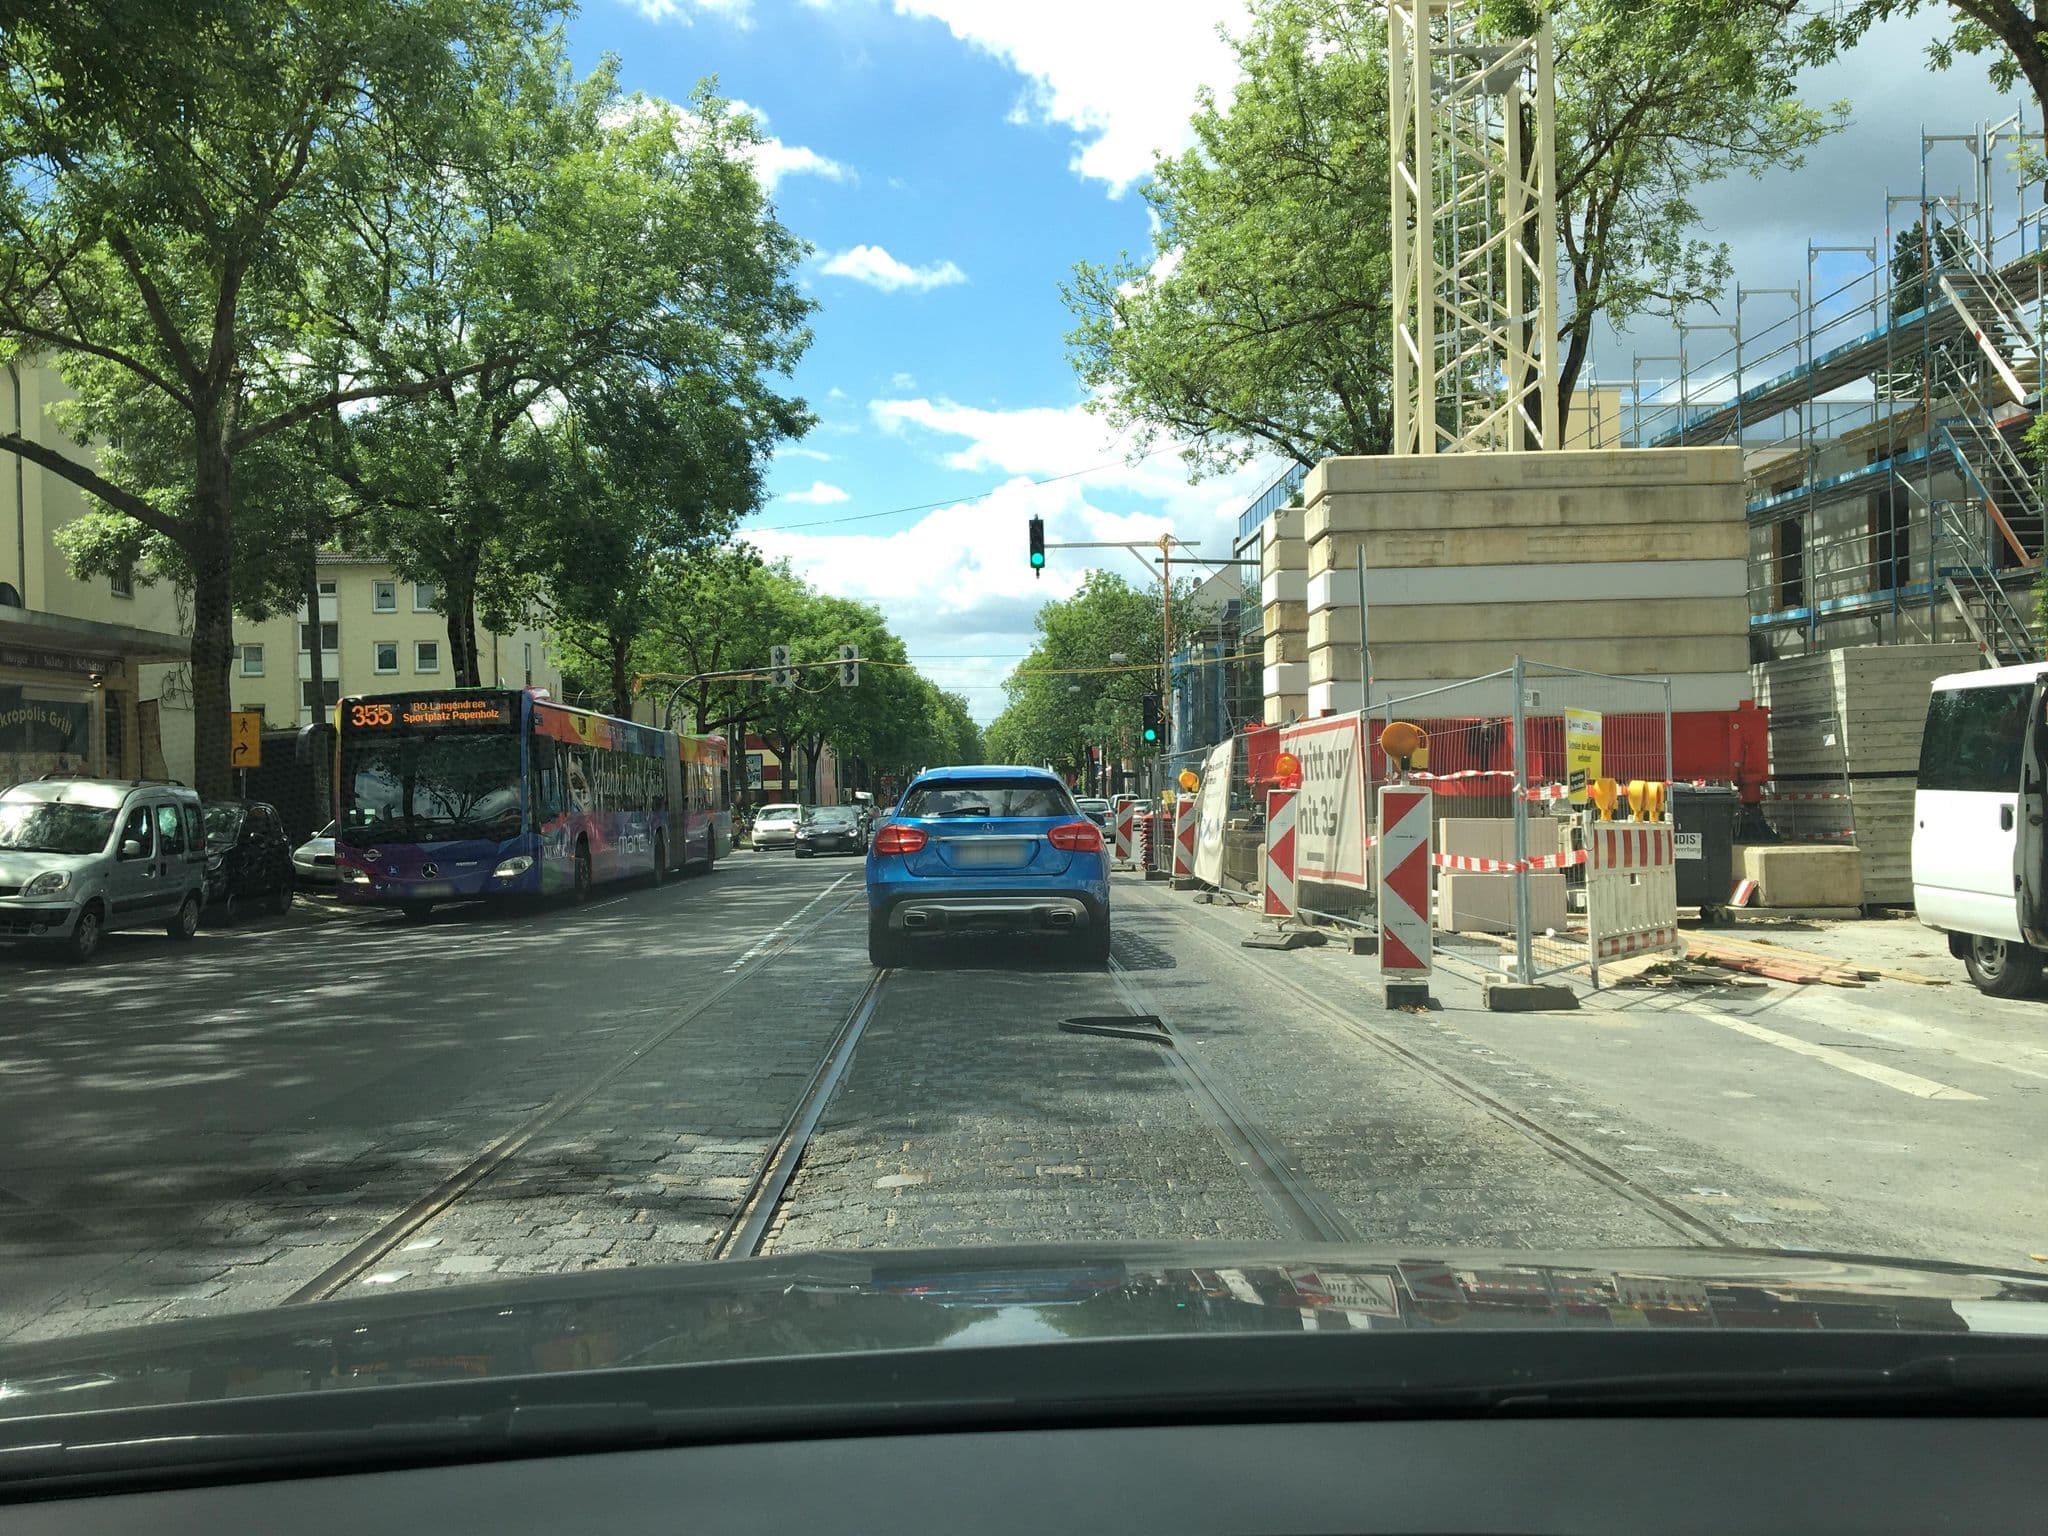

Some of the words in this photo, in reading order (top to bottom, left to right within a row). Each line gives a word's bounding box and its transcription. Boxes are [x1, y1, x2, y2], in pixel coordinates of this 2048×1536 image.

[352, 704, 393, 726] 355
[413, 700, 487, 712] BO-Langendreer
[0, 705, 46, 728] kropolis
[49, 711, 72, 736] Grill
[403, 711, 450, 724] Sportplatz
[452, 709, 499, 721] Papenholz
